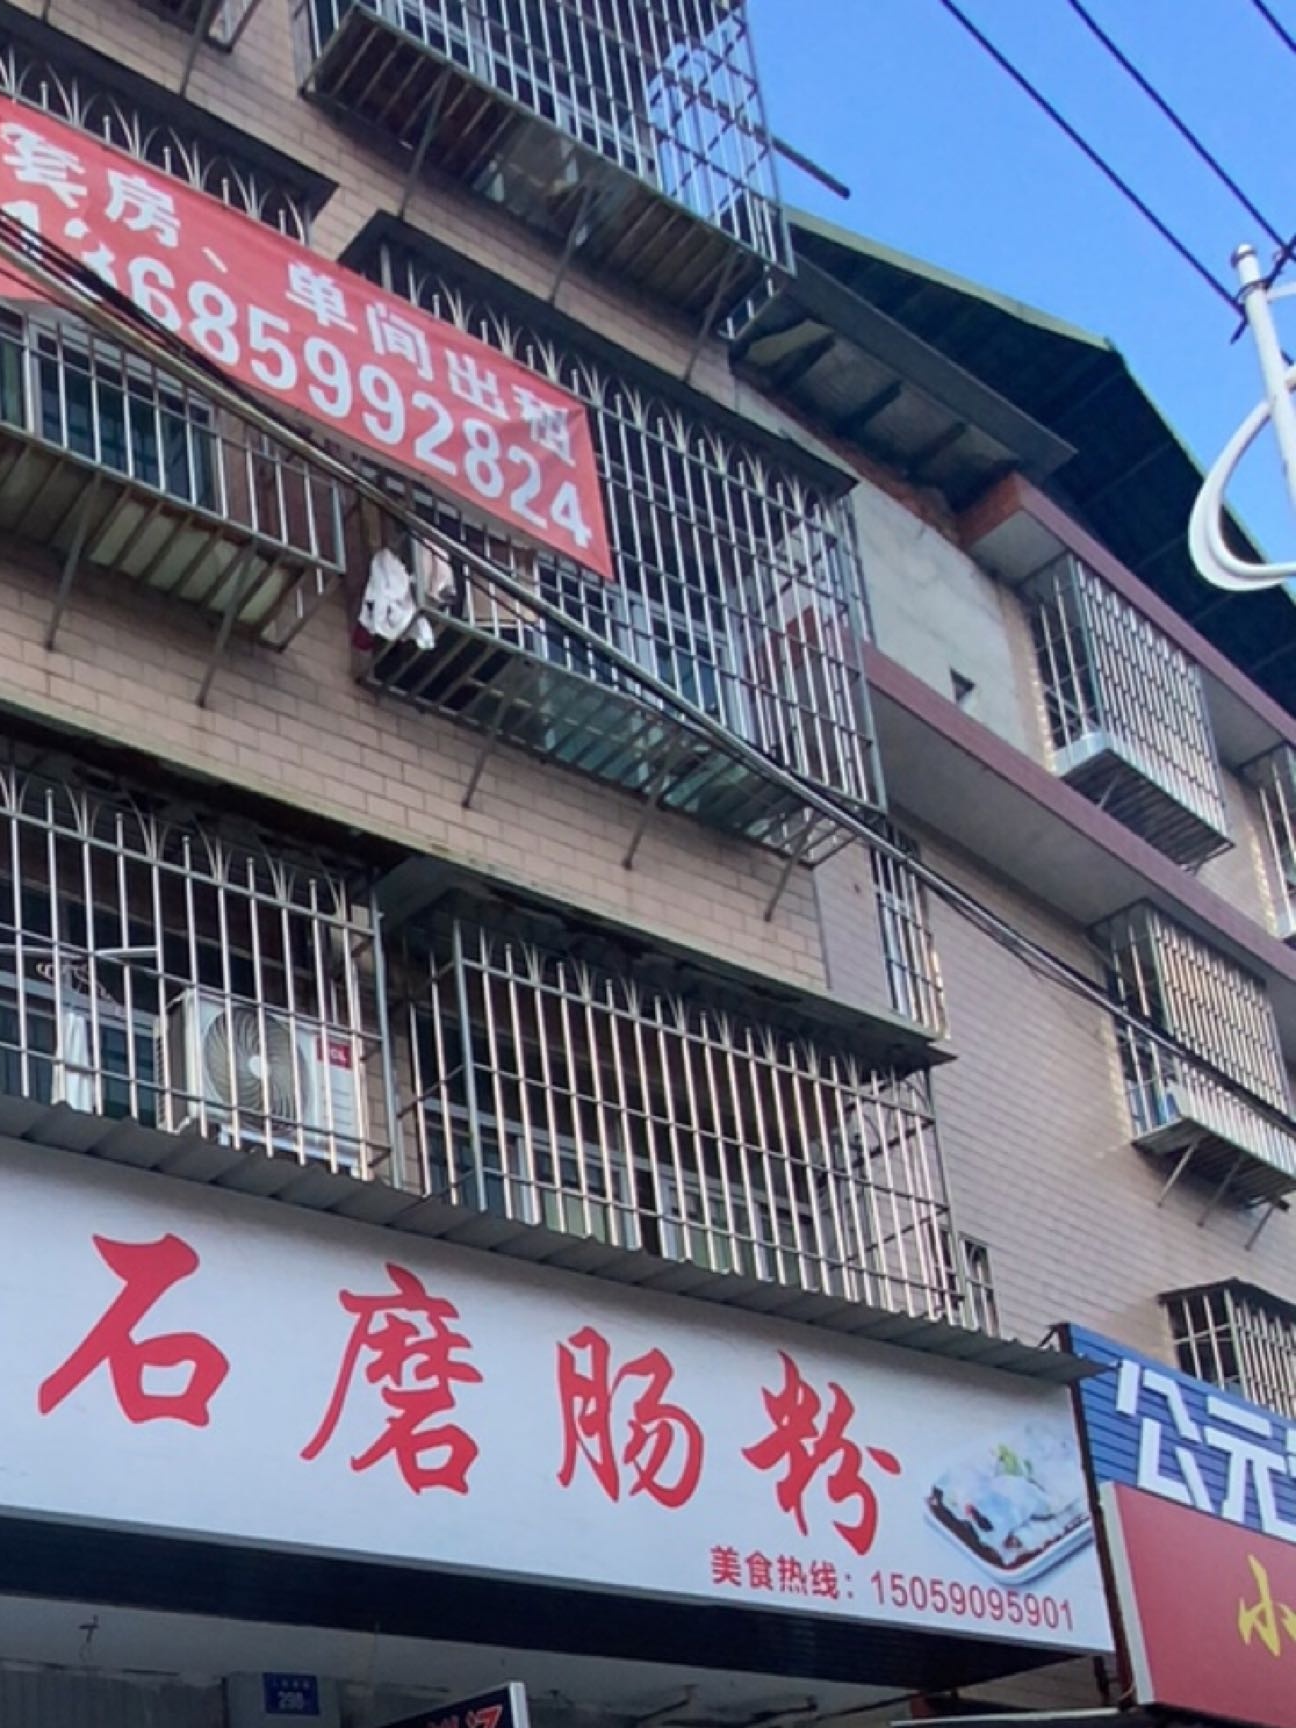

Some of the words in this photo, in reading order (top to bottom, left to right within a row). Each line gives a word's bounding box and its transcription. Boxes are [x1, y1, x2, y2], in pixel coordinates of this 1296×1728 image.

[38, 1233, 902, 1555] 石磨肠粉
[1114, 1357, 1296, 1544] 公元
